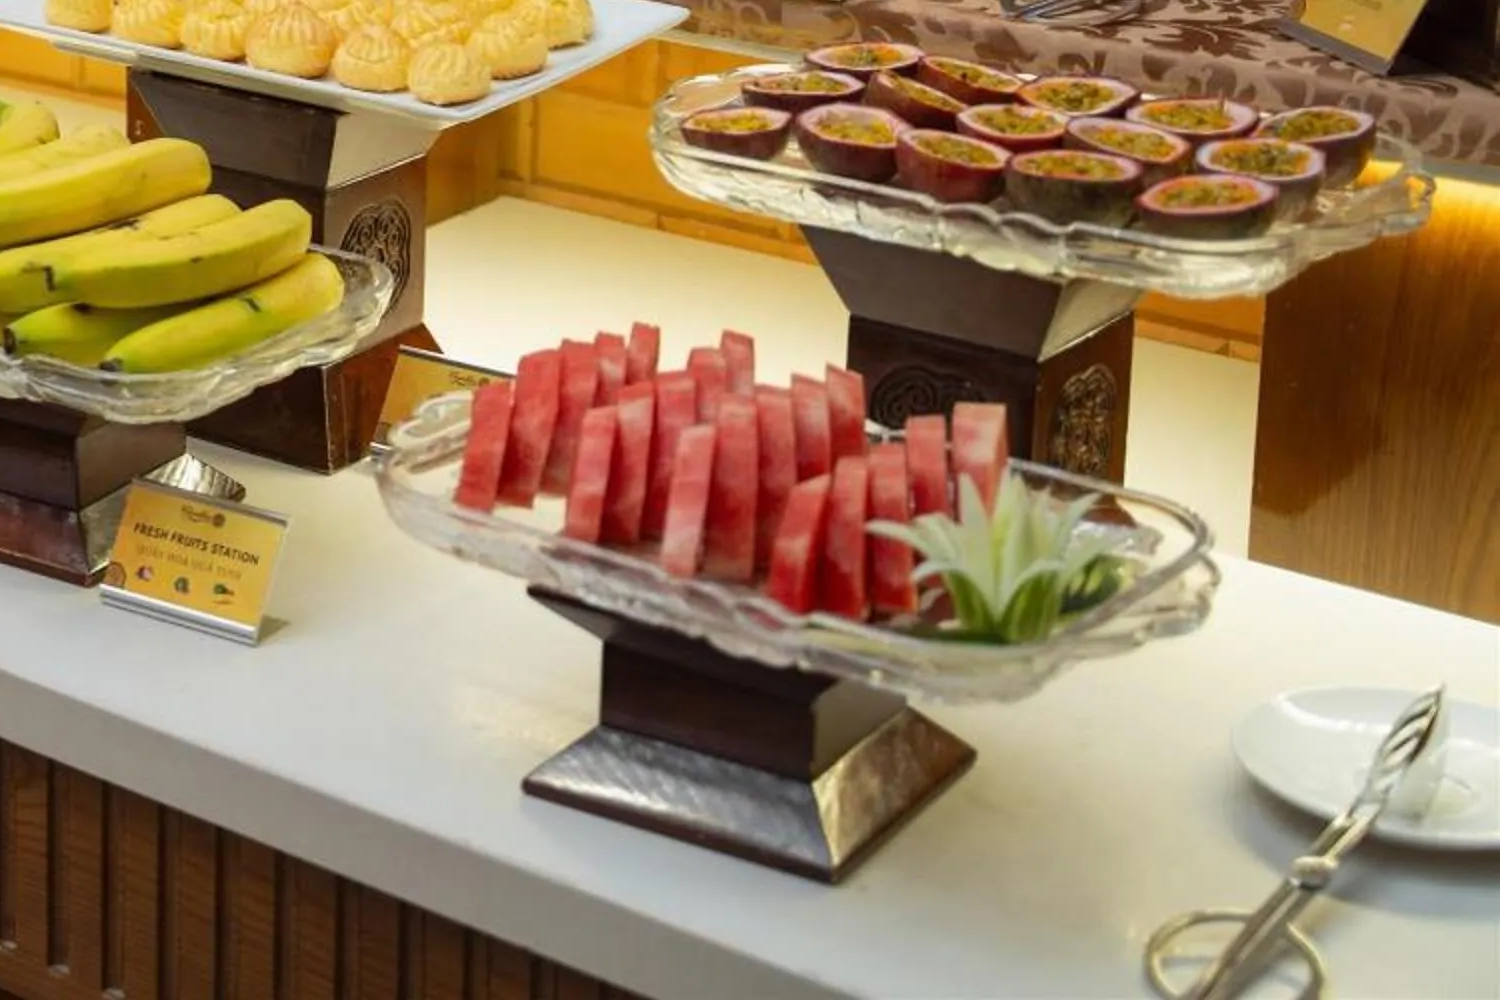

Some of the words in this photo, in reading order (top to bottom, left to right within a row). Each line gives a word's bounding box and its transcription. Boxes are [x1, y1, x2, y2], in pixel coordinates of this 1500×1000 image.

[132, 522, 168, 540] FRESH
[169, 530, 208, 552] FRUITS
[210, 543, 260, 566] STATION
